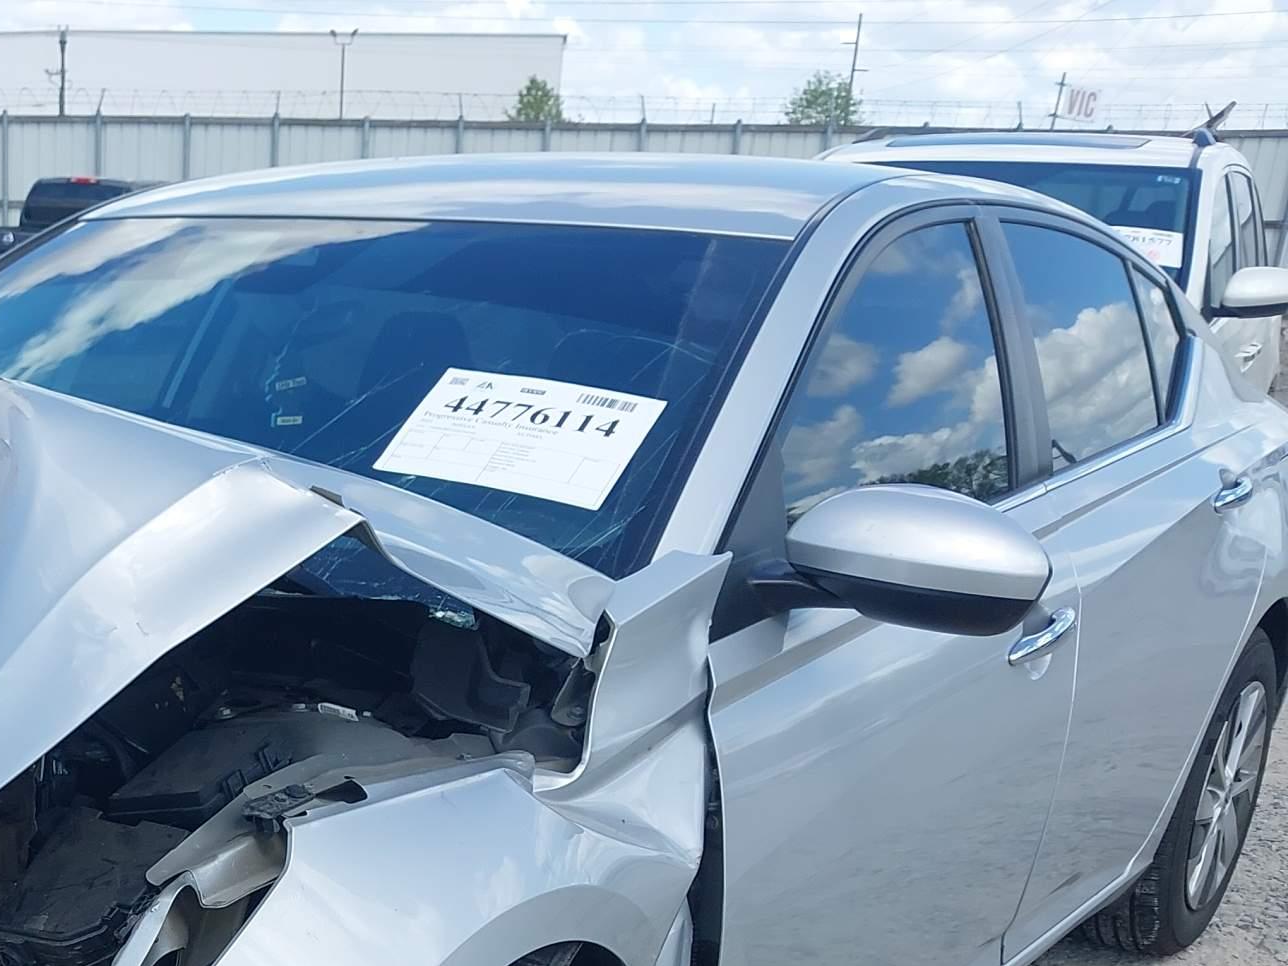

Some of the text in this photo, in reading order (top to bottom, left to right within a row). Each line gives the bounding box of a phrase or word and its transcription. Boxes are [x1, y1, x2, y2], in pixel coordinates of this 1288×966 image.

[1068, 89, 1097, 118] VIC
[423, 410, 472, 423] Progressive
[514, 423, 559, 435] Insurance
[444, 395, 620, 437] 44776114
